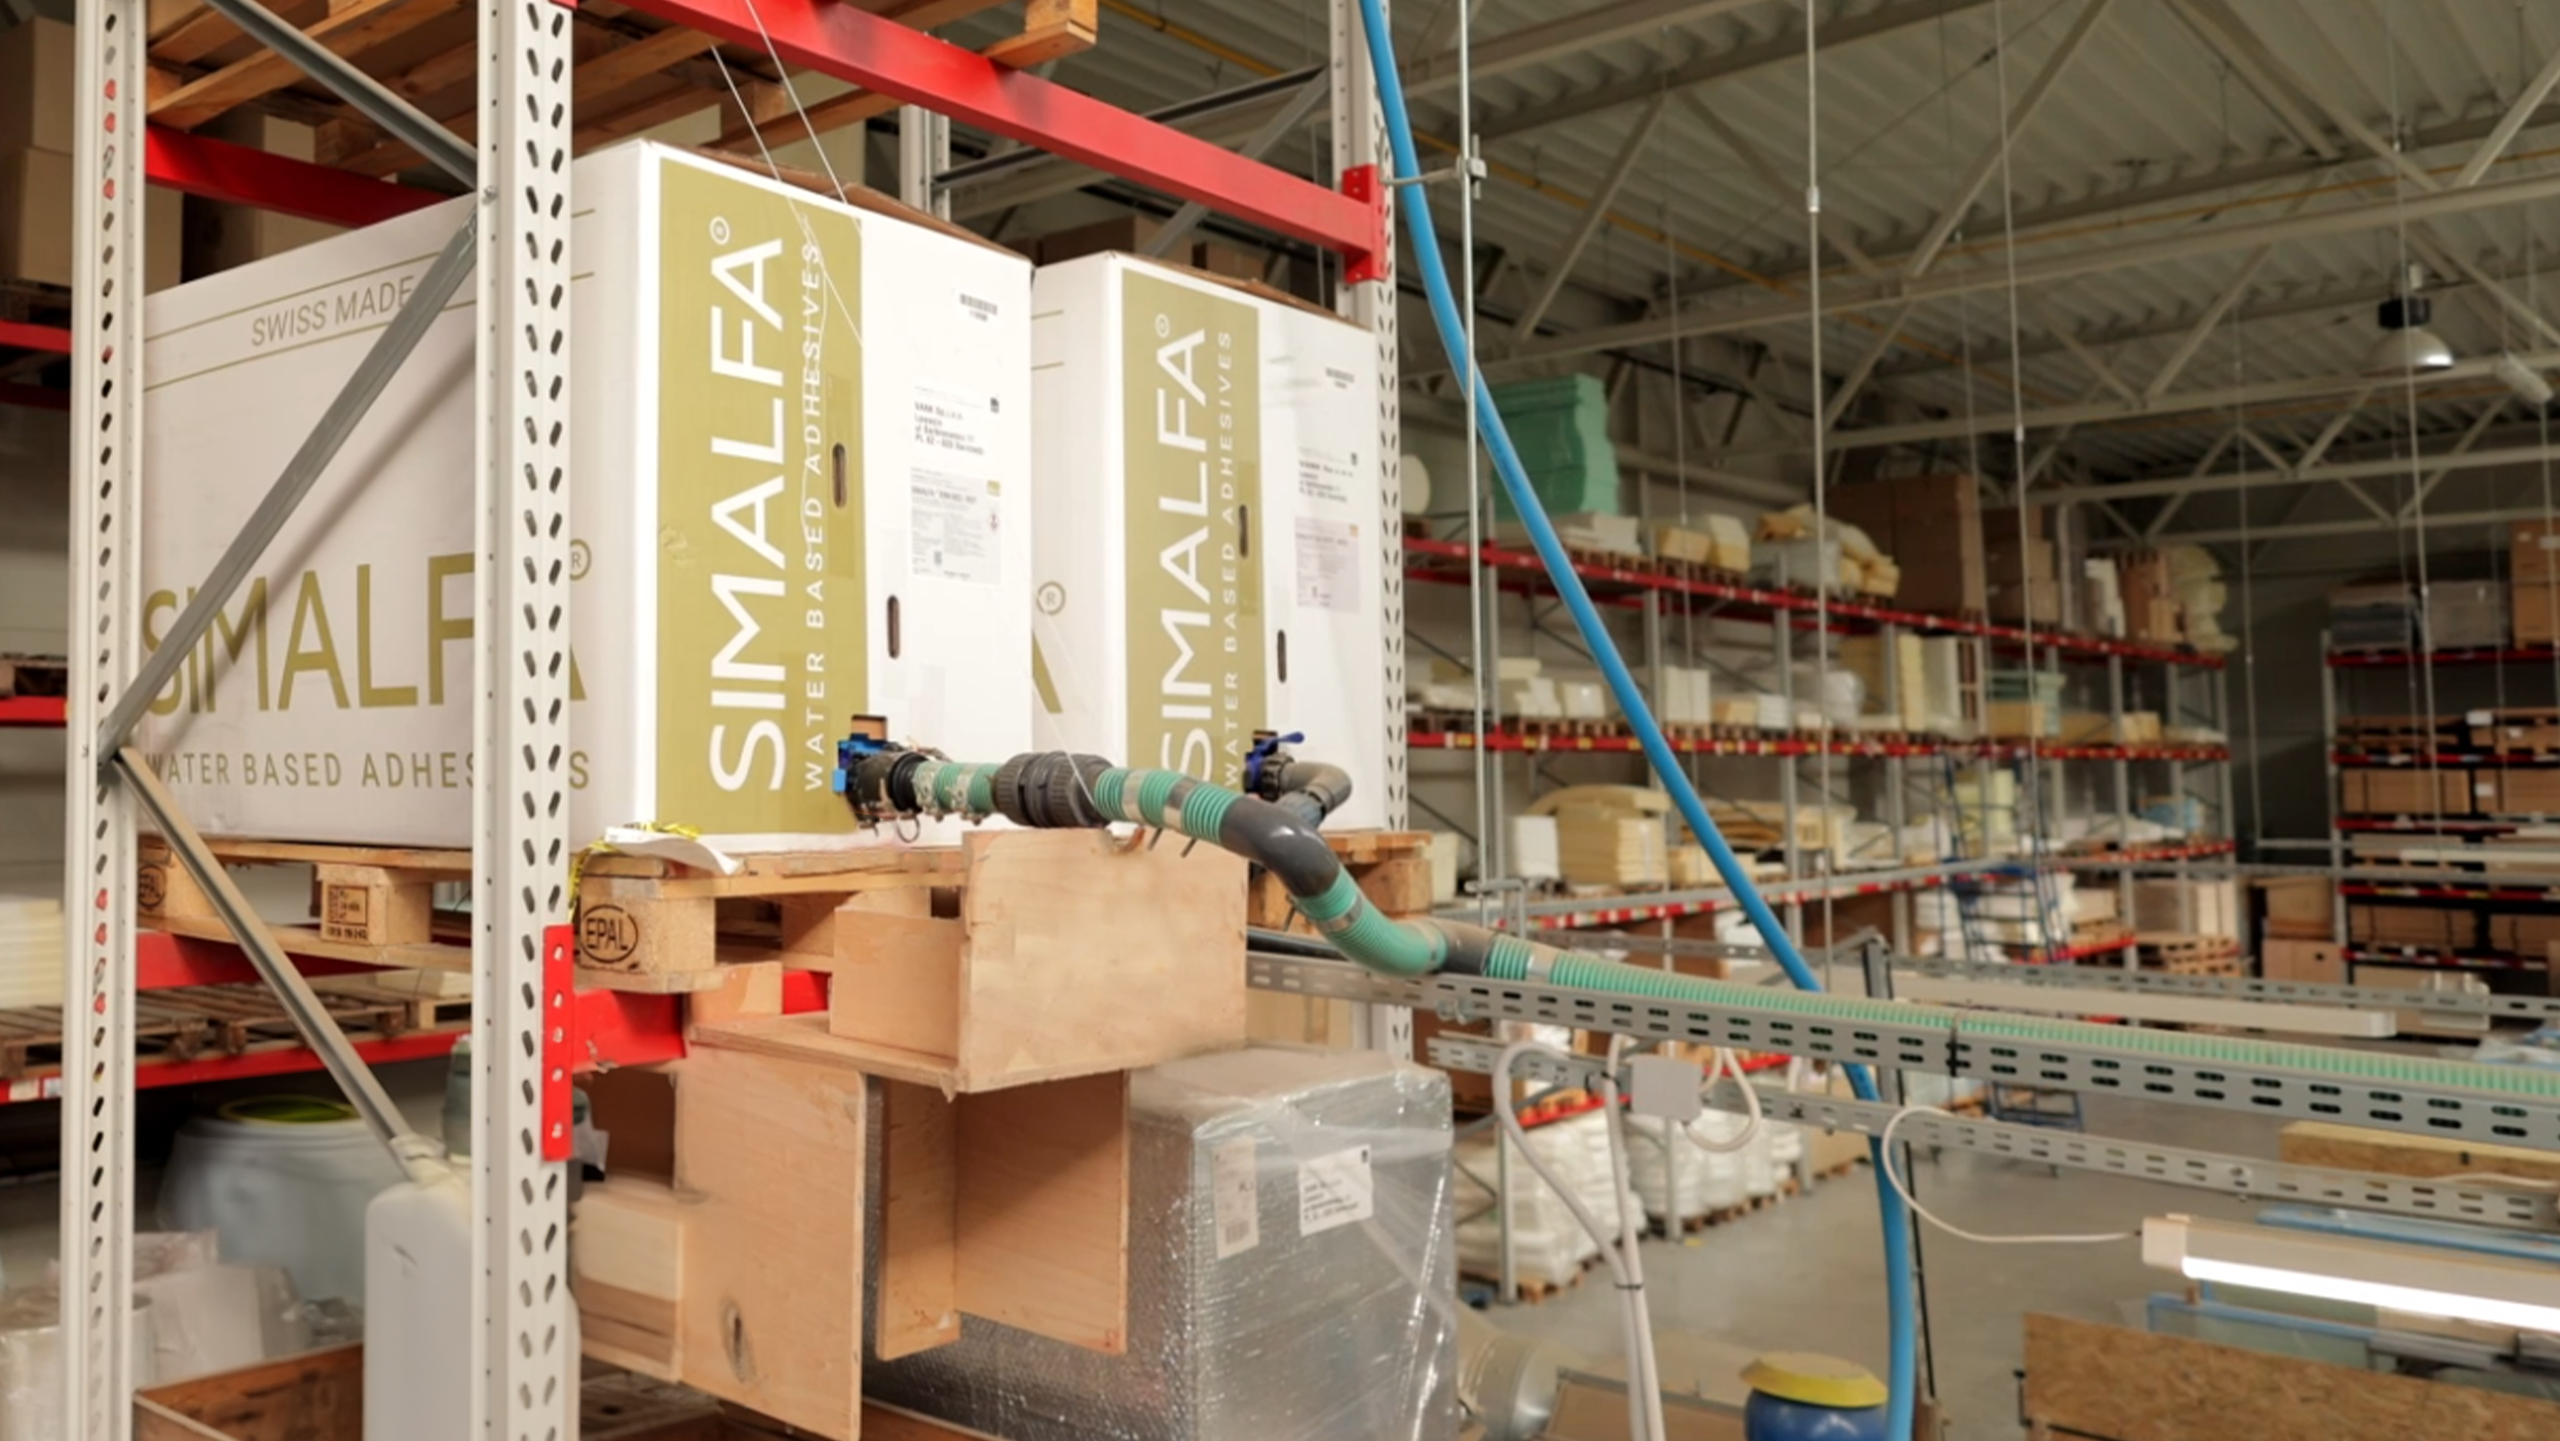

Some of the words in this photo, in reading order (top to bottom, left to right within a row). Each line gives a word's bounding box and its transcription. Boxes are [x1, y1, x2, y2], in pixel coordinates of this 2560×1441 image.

[252, 300, 327, 347] SWISS
[802, 241, 822, 475] ADHESIVES
[1218, 332, 1234, 525] ADHESIVES
[803, 498, 824, 629] BASED
[1222, 544, 1237, 652] BASED
[243, 752, 342, 788] BASED
[804, 653, 825, 791] WATER
[1223, 673, 1238, 788] WATER
[586, 917, 629, 951] EPAL
